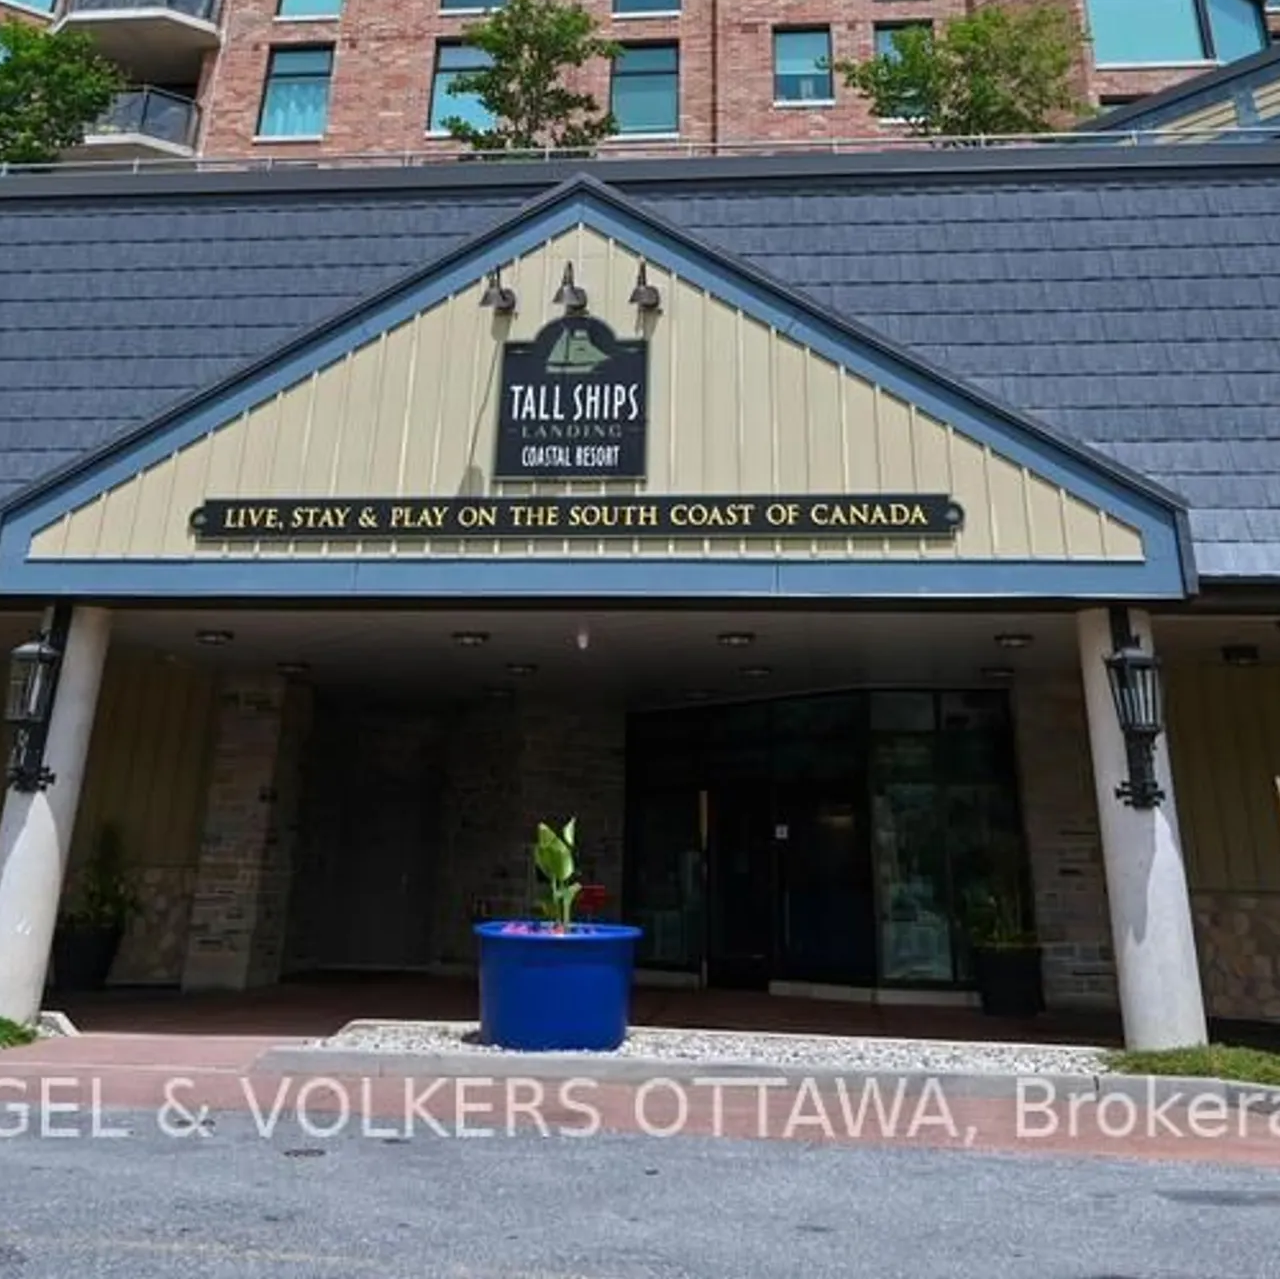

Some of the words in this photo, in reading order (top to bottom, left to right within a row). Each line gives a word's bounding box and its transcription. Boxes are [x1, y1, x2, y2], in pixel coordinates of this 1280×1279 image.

[510, 385, 565, 421] TALL
[572, 383, 639, 421] SHIPS
[521, 424, 623, 439] LANDING
[521, 445, 572, 467] COASTAL
[575, 445, 620, 467] RESORT
[223, 508, 284, 530] LIVE,
[291, 507, 350, 528] STAY
[358, 507, 378, 527] &
[390, 506, 449, 527] PLAY
[458, 506, 497, 527] ON
[510, 506, 558, 526] THE
[570, 505, 658, 526] SOUTH
[671, 504, 755, 526] COAST
[766, 504, 801, 525] OF
[811, 504, 928, 525] CANADA
